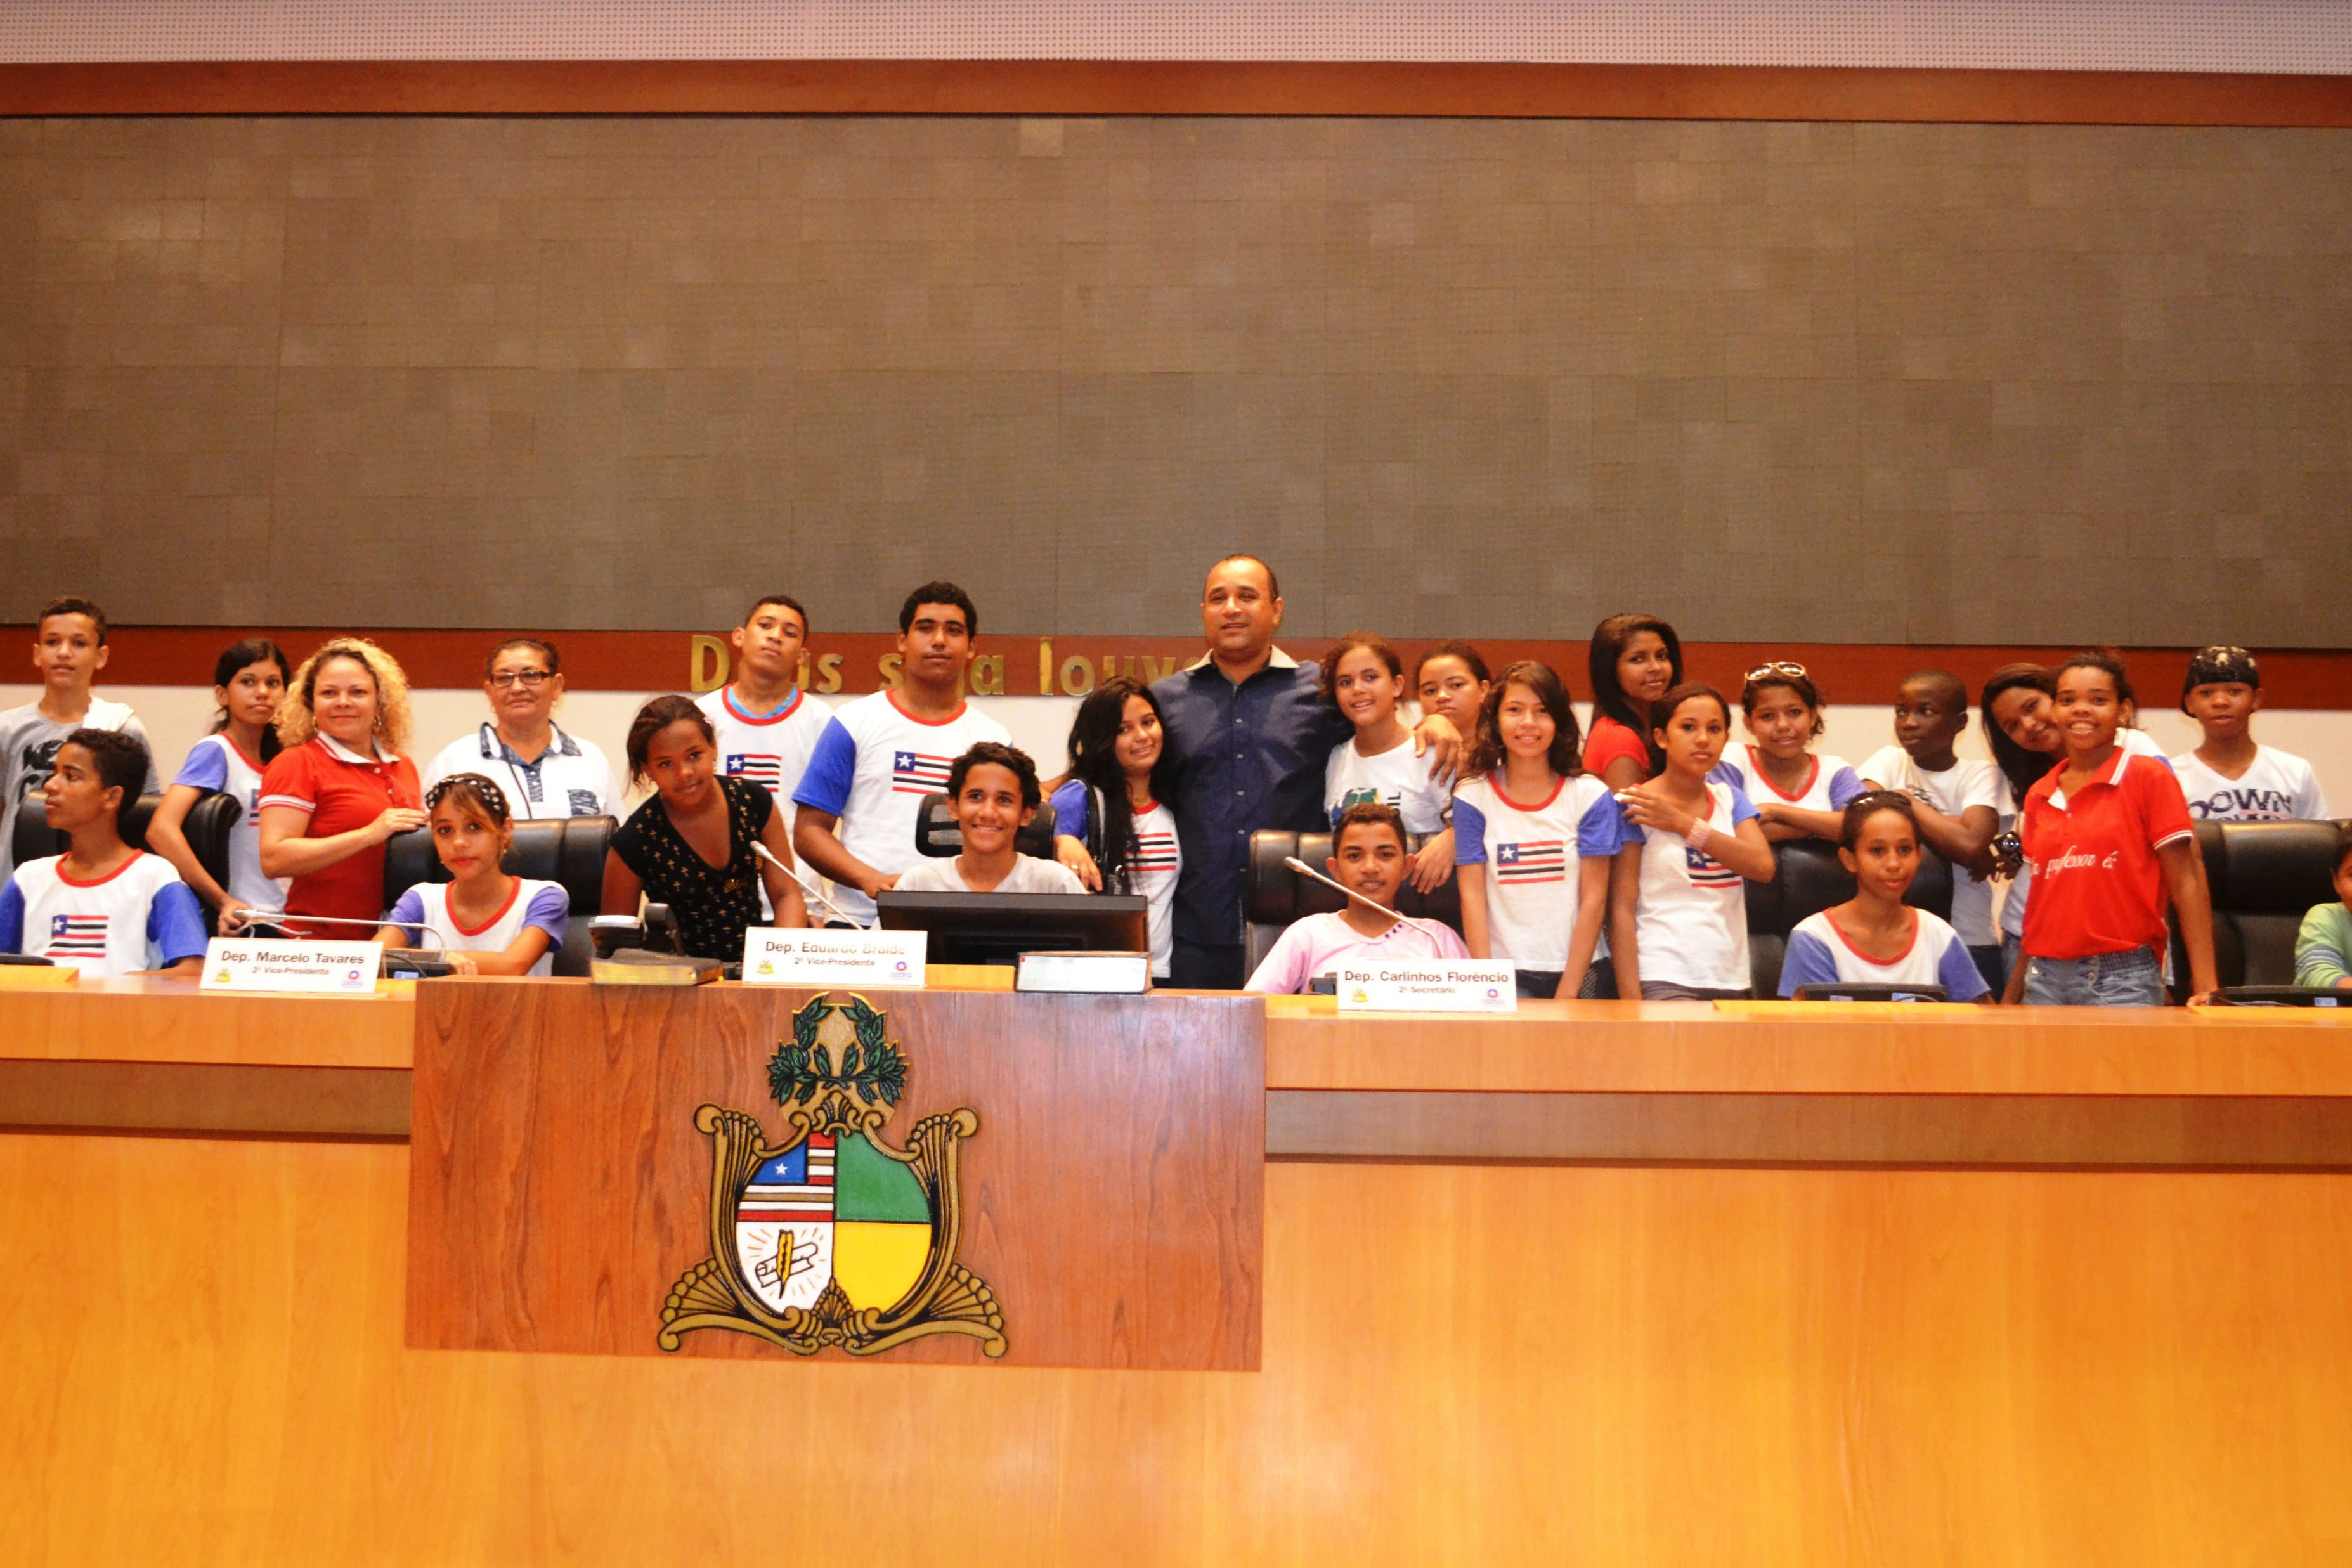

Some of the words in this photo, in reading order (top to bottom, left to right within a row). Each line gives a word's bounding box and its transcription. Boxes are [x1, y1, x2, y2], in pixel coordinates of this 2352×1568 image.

[691, 634, 843, 694] Ds
[878, 653, 1004, 697] sa
[766, 941, 795, 954] Dep.
[802, 942, 857, 953] Eduardo
[221, 951, 250, 964] Dep.
[256, 952, 309, 962] Marcelo
[316, 953, 365, 964] Tavares
[807, 957, 876, 966] Vice-Presidente
[264, 966, 330, 975] Vice-Presidente
[1344, 971, 1374, 983] Dep.
[1381, 971, 1442, 982] Carlinhos
[1448, 971, 1509, 983] Florêncio
